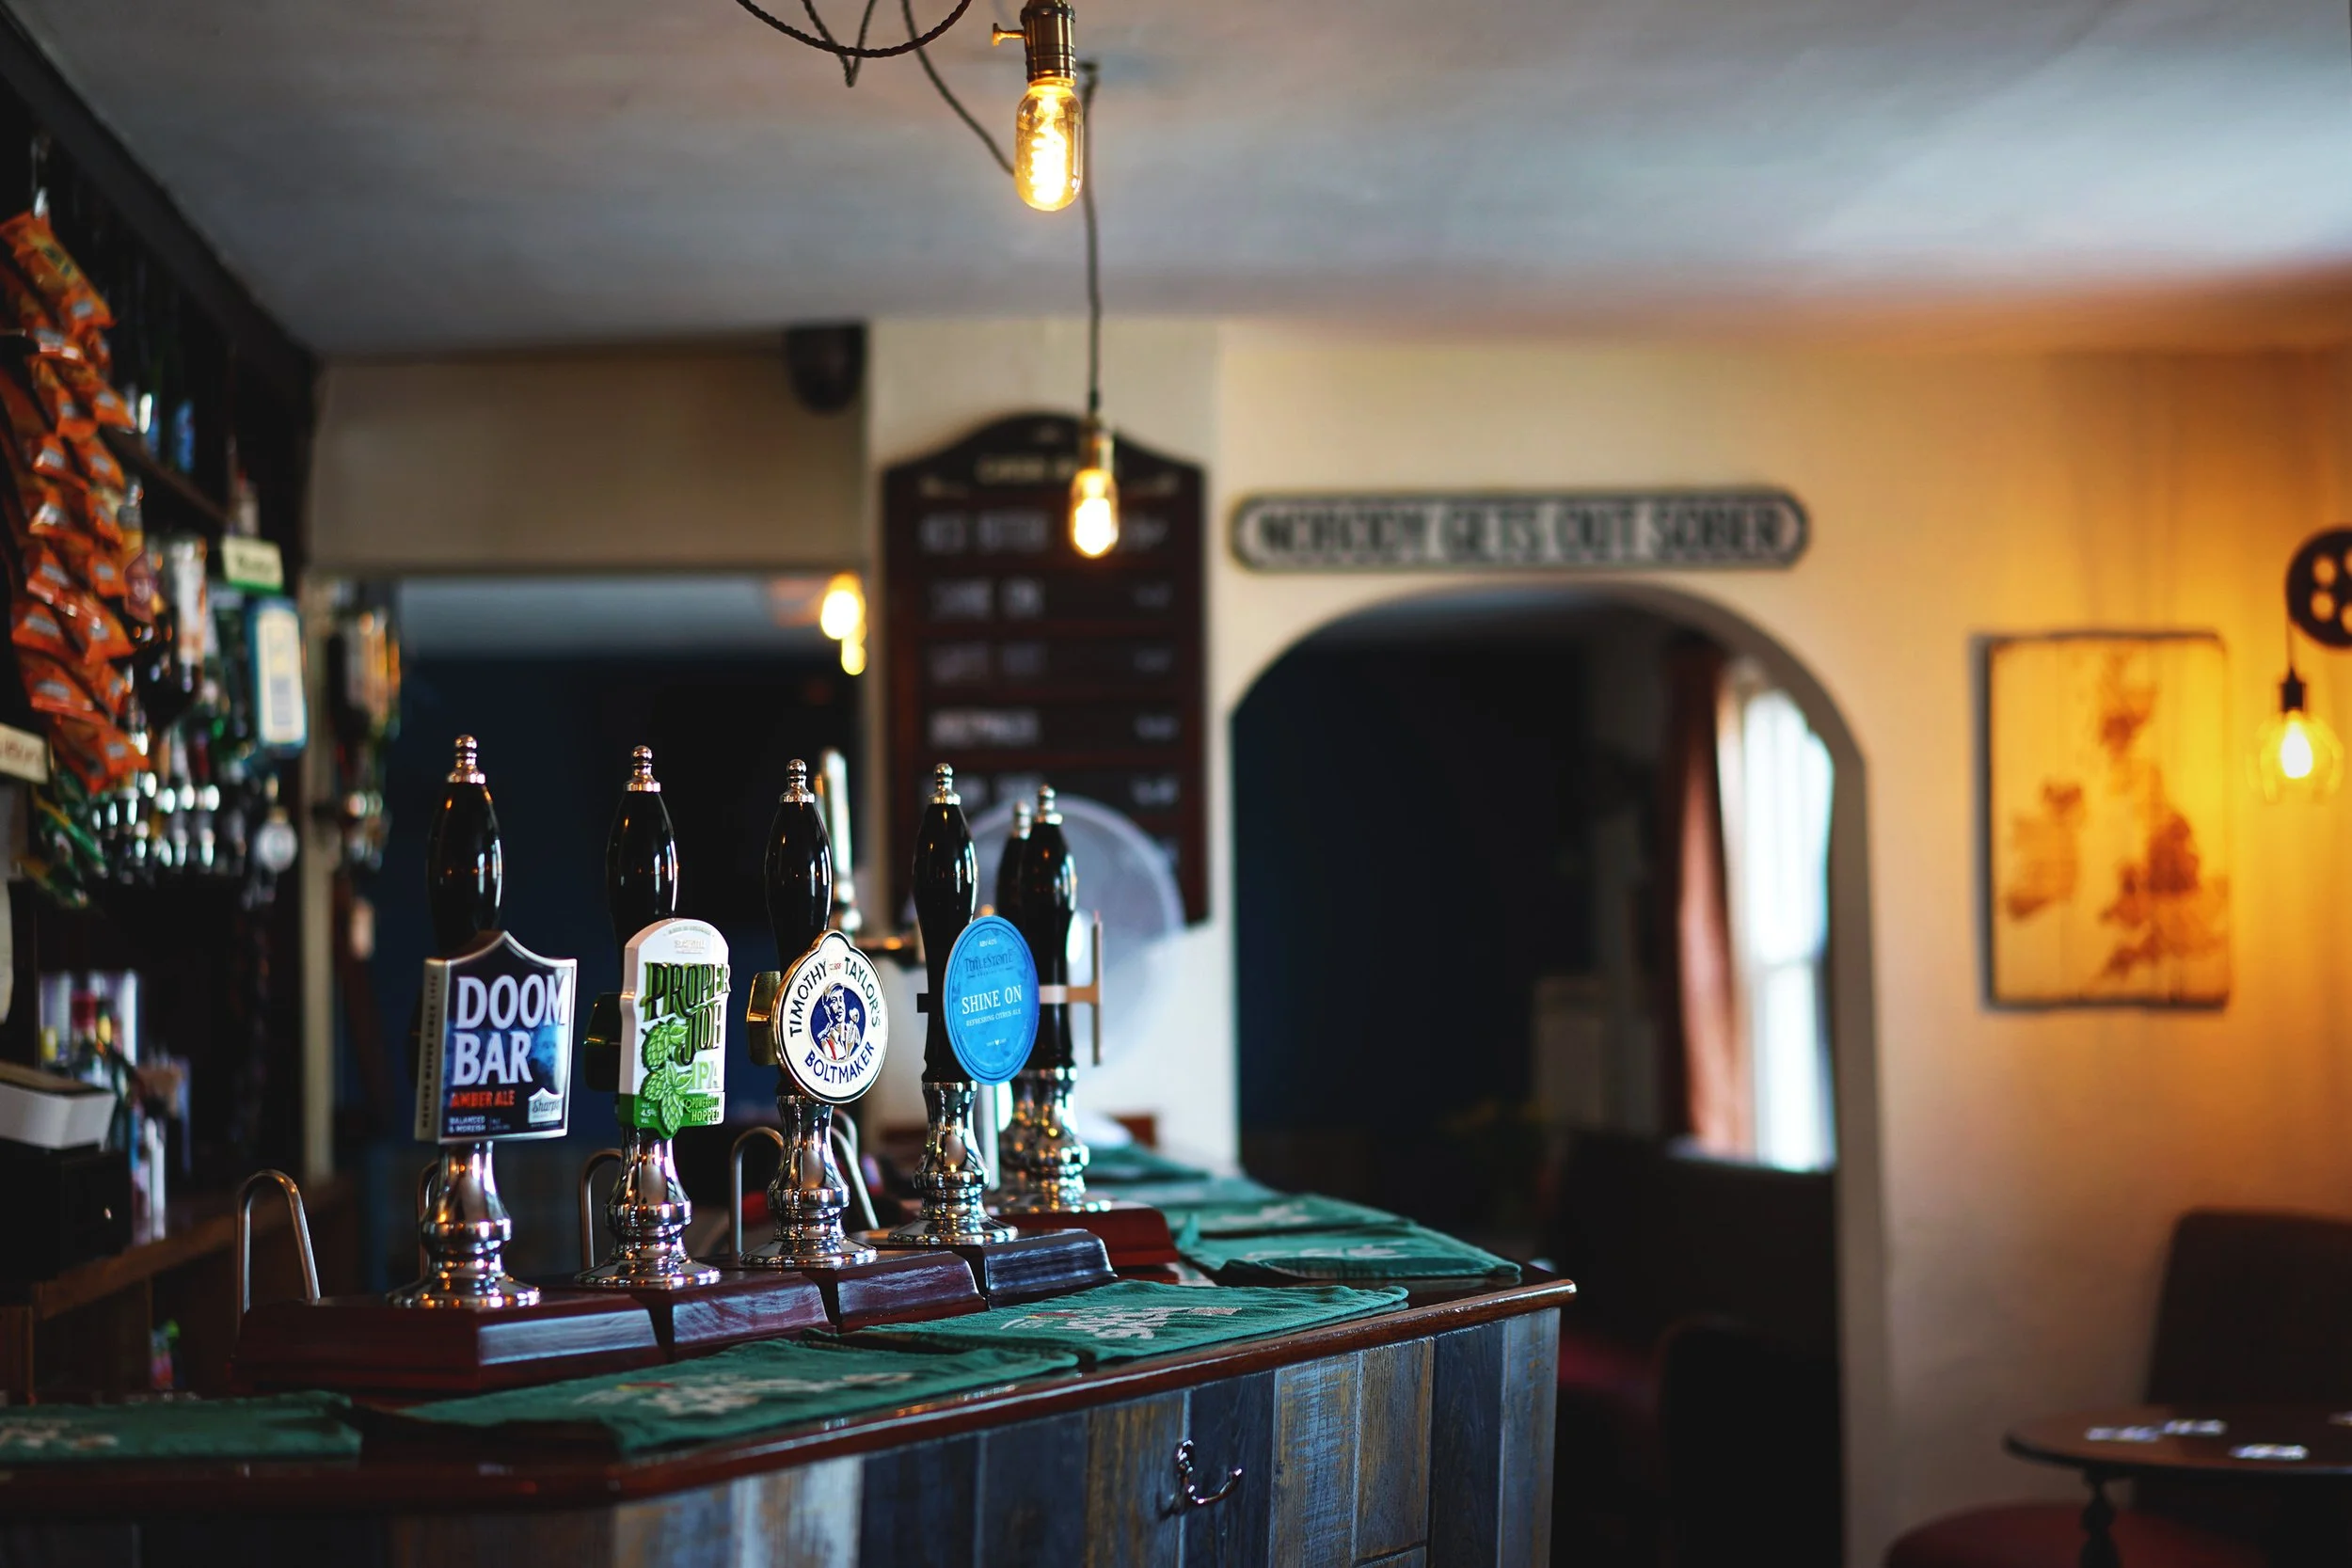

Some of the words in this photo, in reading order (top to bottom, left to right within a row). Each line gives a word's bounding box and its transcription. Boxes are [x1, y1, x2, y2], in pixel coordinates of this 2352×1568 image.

[455, 974, 570, 1030] DOOM
[640, 962, 731, 1022] PROPER
[789, 958, 829, 1037] TIMOTHY
[844, 957, 881, 1028] TAYLOR'S
[961, 990, 1001, 1015] SHINE
[1005, 985, 1022, 1005] ON
[674, 1000, 723, 1067] JOB
[965, 1015, 994, 1027] REFRESHING
[994, 1010, 1012, 1021] CITRUS
[452, 1030, 533, 1086] BAR
[690, 1060, 721, 1089] IPA
[804, 1041, 874, 1085] BOLTMAKER
[450, 1091, 493, 1108] AMBER
[494, 1089, 516, 1106] ALE
[691, 1109, 720, 1122] HOPPED
